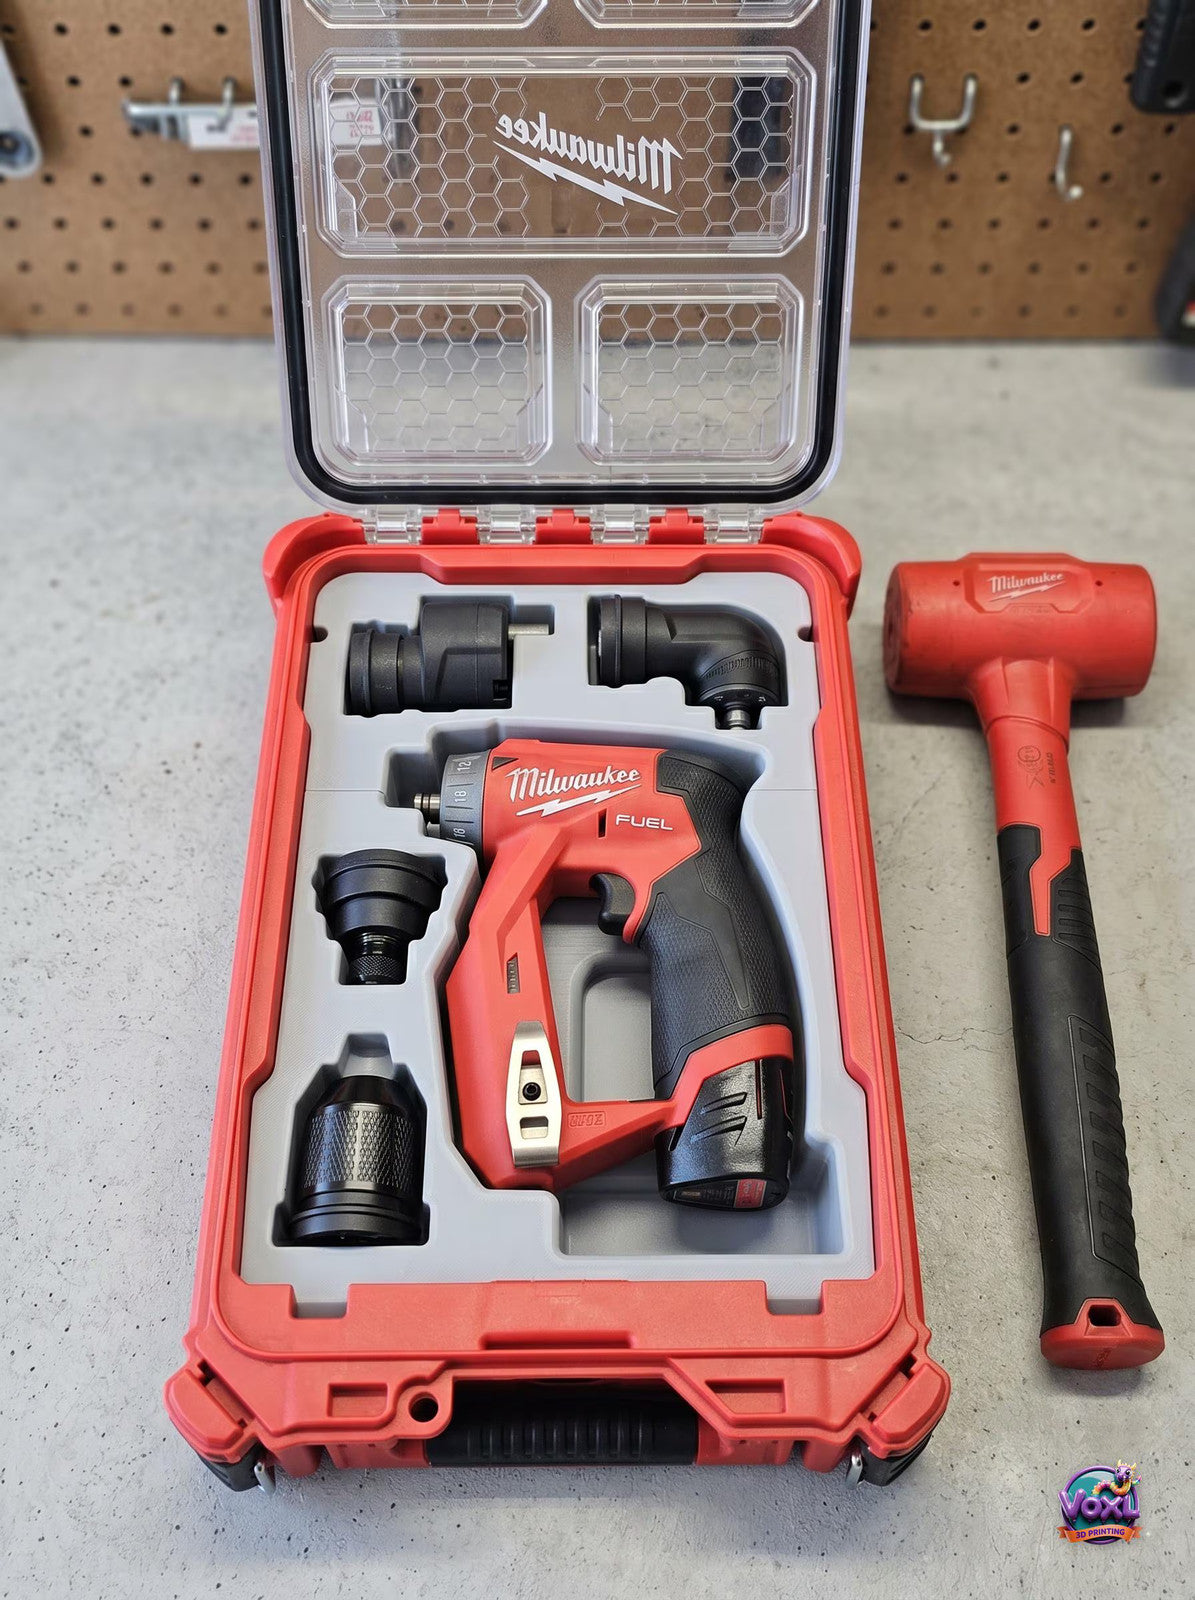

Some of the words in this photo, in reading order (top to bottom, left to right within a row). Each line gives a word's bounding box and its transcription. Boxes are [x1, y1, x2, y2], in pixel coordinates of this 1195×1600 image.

[986, 571, 1064, 594] Milwaukee
[457, 760, 472, 771] 12
[505, 765, 641, 803] Milwaukee
[454, 790, 468, 803] 18
[615, 814, 673, 831] FUEL
